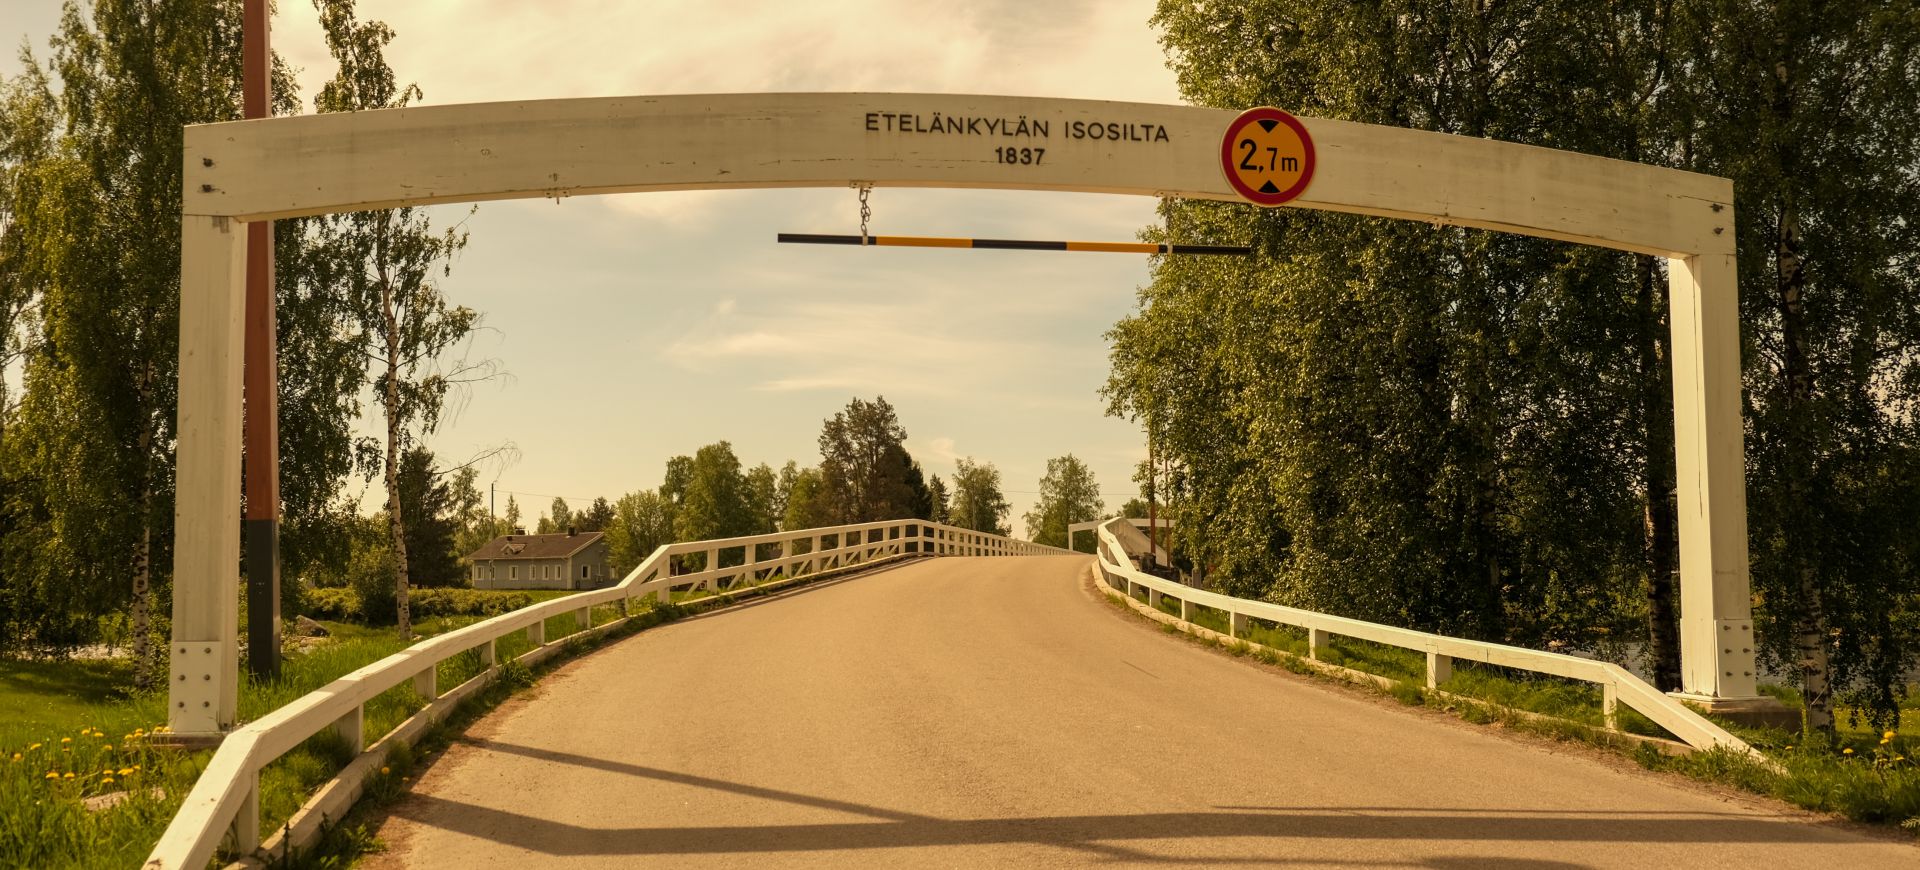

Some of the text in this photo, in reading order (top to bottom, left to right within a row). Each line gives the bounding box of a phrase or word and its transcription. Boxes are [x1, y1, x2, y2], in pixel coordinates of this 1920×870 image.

[866, 113, 1169, 143] ETELÄNKYLÄN ISOSILTA
[996, 148, 1045, 165] 1837
